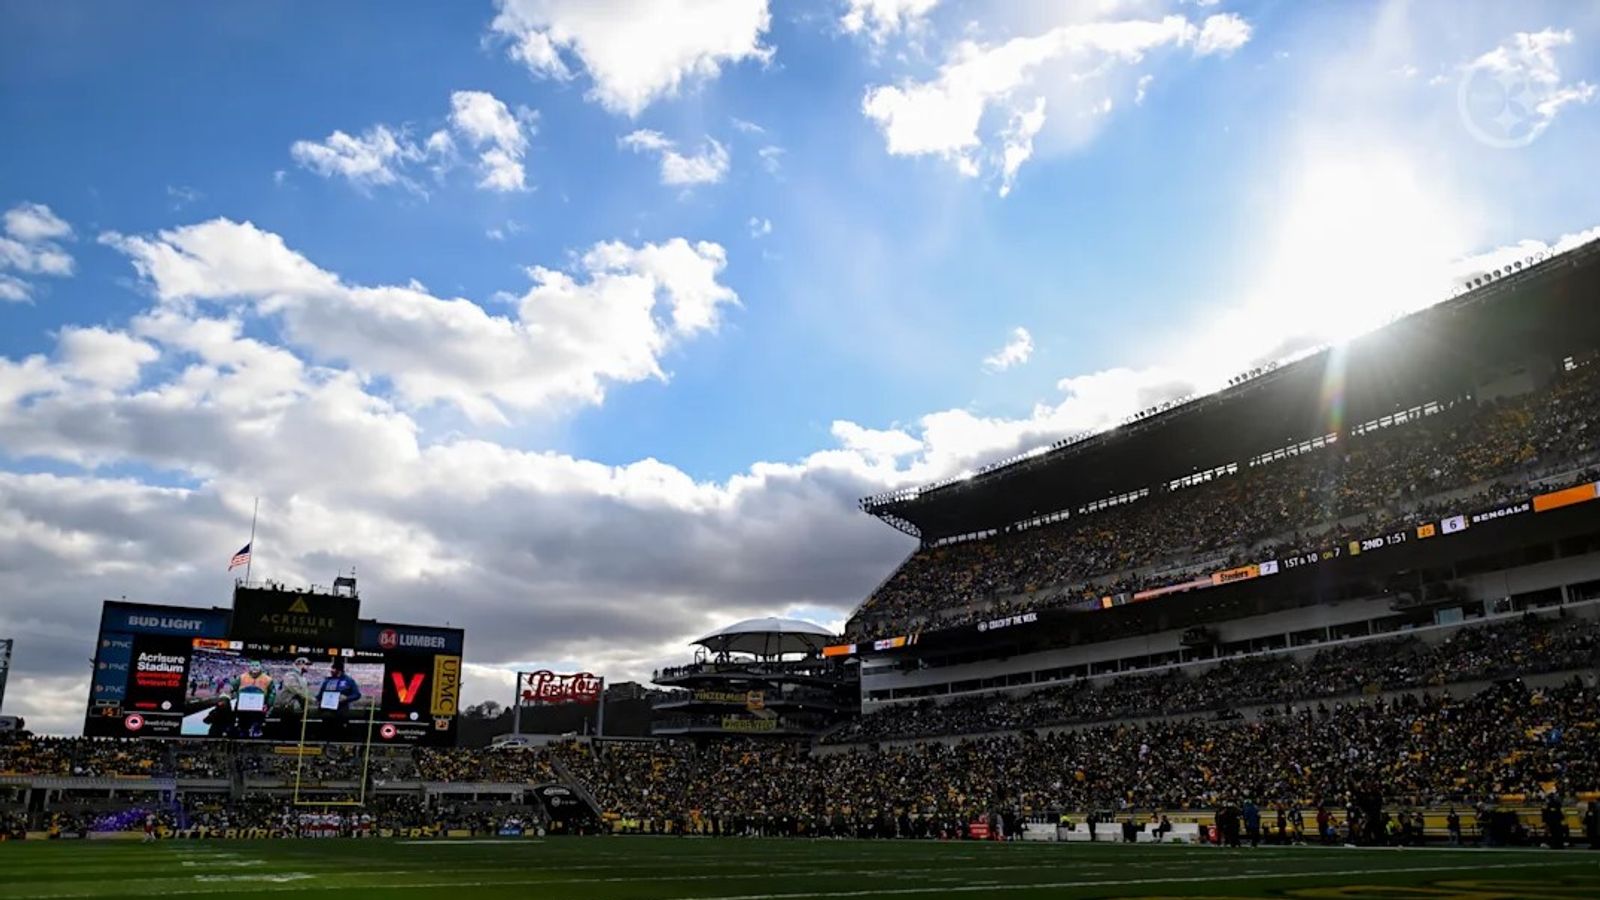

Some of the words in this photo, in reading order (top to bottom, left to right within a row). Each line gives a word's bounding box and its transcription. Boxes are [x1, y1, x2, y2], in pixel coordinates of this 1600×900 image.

[1285, 557, 1298, 568] 1ST
[1307, 553, 1318, 563] 10
[1334, 548, 1340, 557] 7
[1362, 537, 1383, 551] 2ND
[1386, 532, 1407, 546] 1:51
[1450, 520, 1457, 531] 6
[1473, 503, 1530, 523] BENGALS
[128, 615, 160, 627] BUD
[161, 618, 203, 631] LIGHT
[260, 614, 335, 629] ACRISURE
[273, 625, 319, 635] STADIUM
[381, 633, 398, 645] 84
[399, 633, 446, 649] LUMBER
[138, 651, 186, 664] Acrisure
[137, 662, 185, 673] Stadium
[440, 660, 457, 711] UPMC
